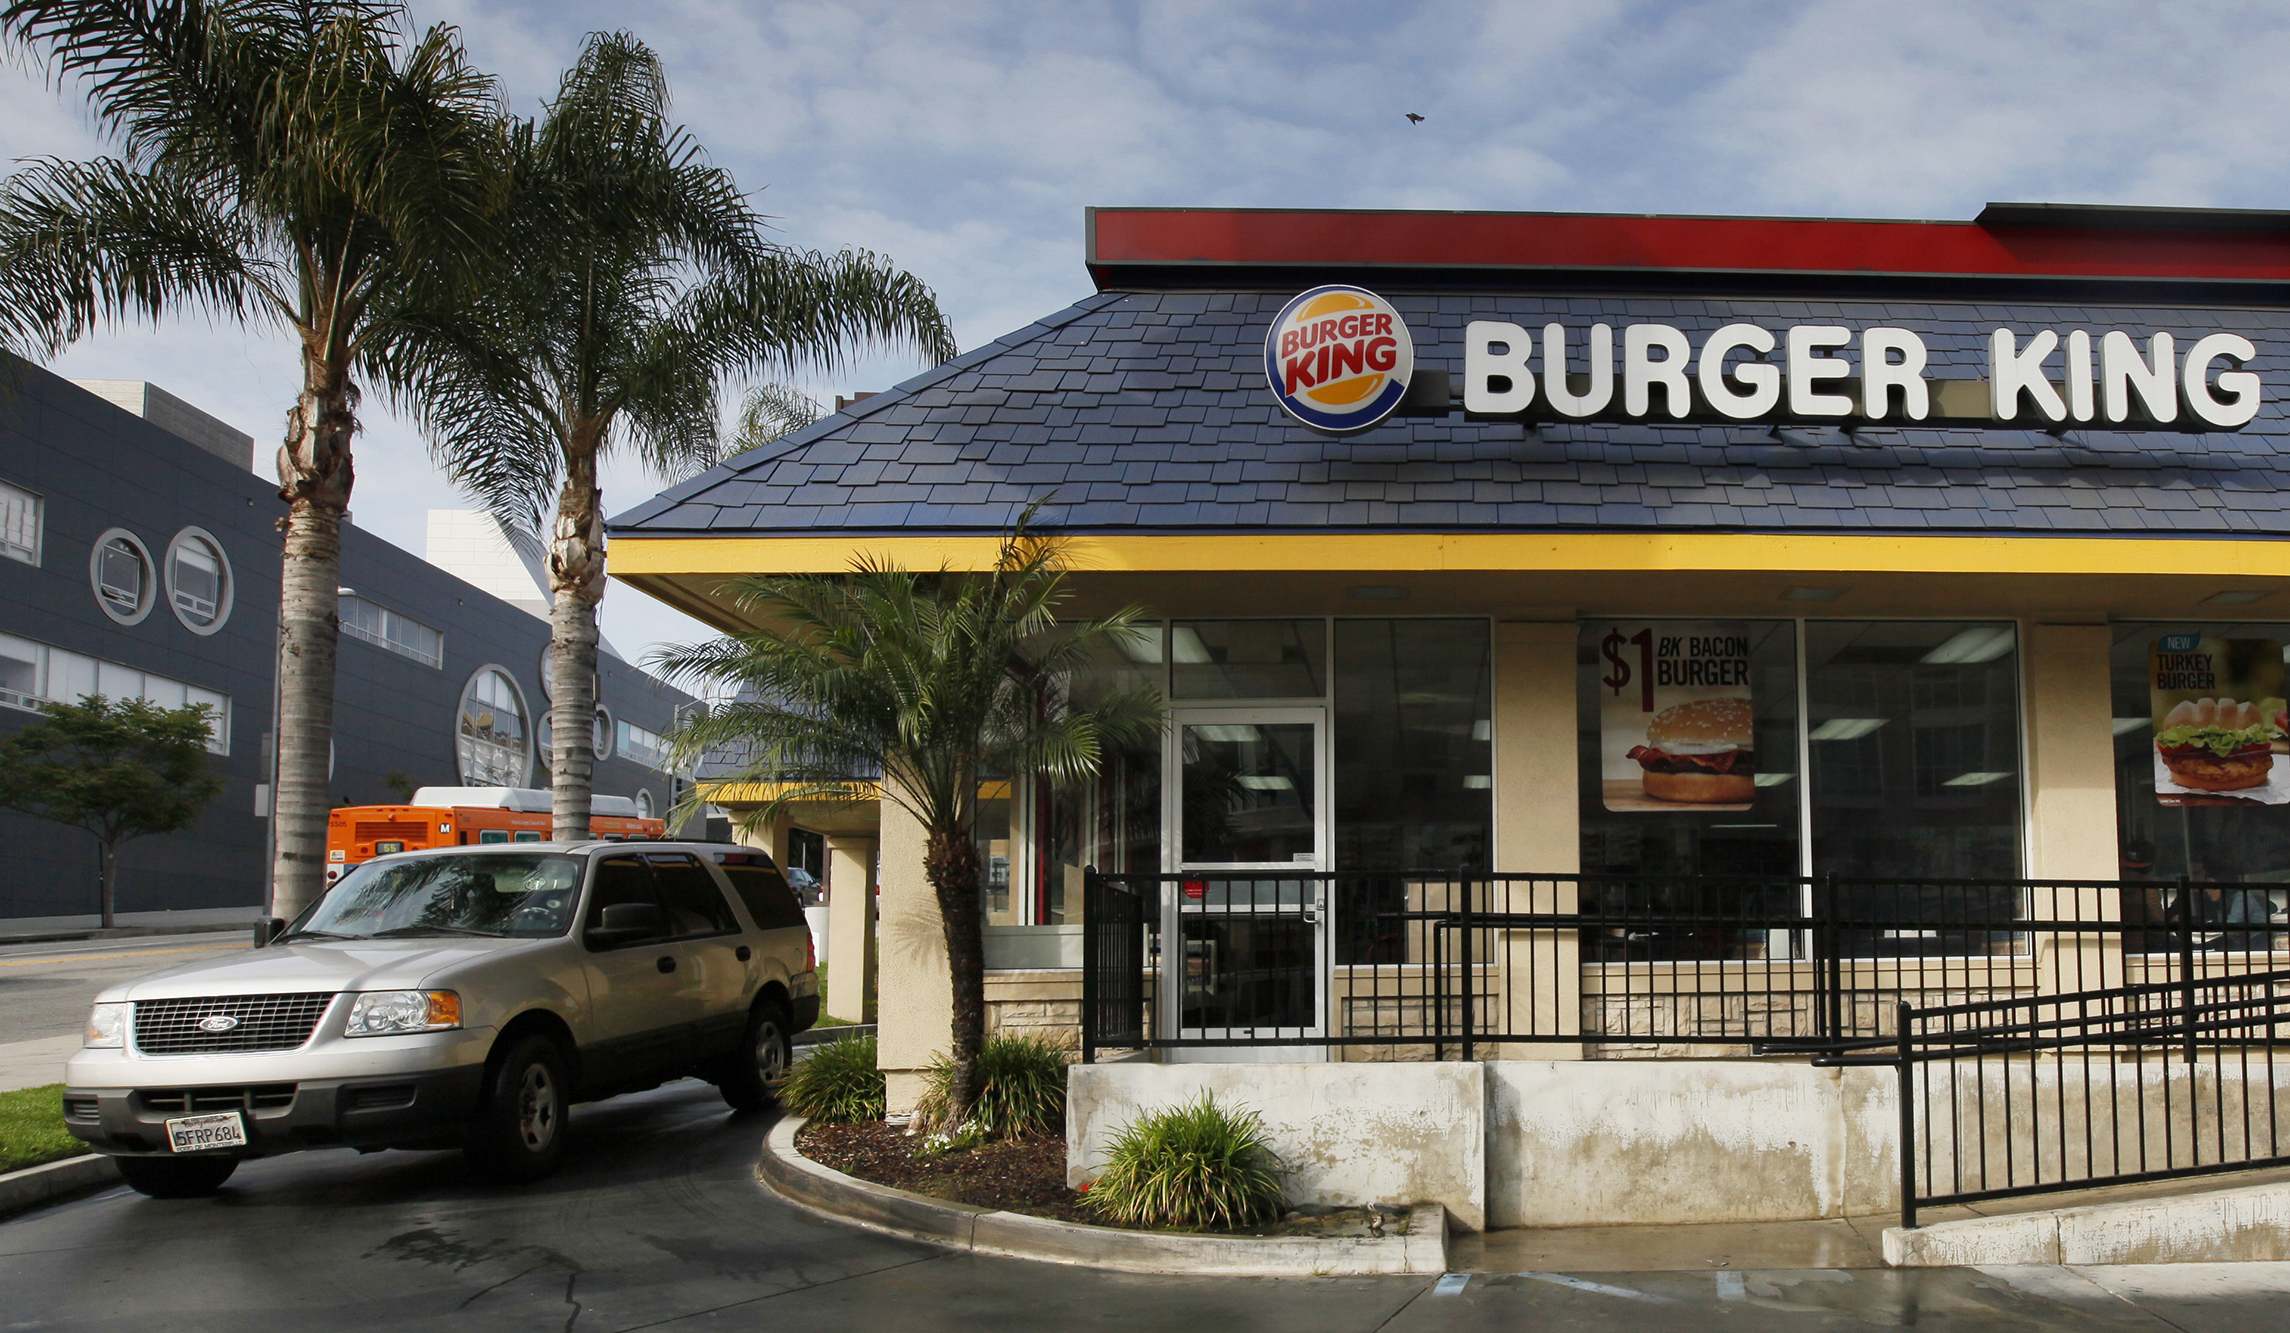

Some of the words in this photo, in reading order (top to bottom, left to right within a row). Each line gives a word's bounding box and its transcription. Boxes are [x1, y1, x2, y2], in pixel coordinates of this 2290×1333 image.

[1281, 313, 1393, 360] BURGER
[1285, 336, 1397, 397] KING
[1464, 319, 1929, 421] BURGER
[1990, 327, 2262, 427] KING
[1657, 637, 1682, 658] BK
[1689, 637, 1748, 658] BACON
[2167, 636, 2191, 649] NEW
[1602, 627, 1654, 713] $1
[1657, 659, 1749, 686] BURGER
[2156, 653, 2213, 672] TURKEY
[2157, 673, 2216, 690] BURGER
[440, 824, 450, 833] M
[383, 843, 397, 853] 55
[207, 1019, 230, 1029] Ford
[175, 1126, 242, 1146] 5FRP684
